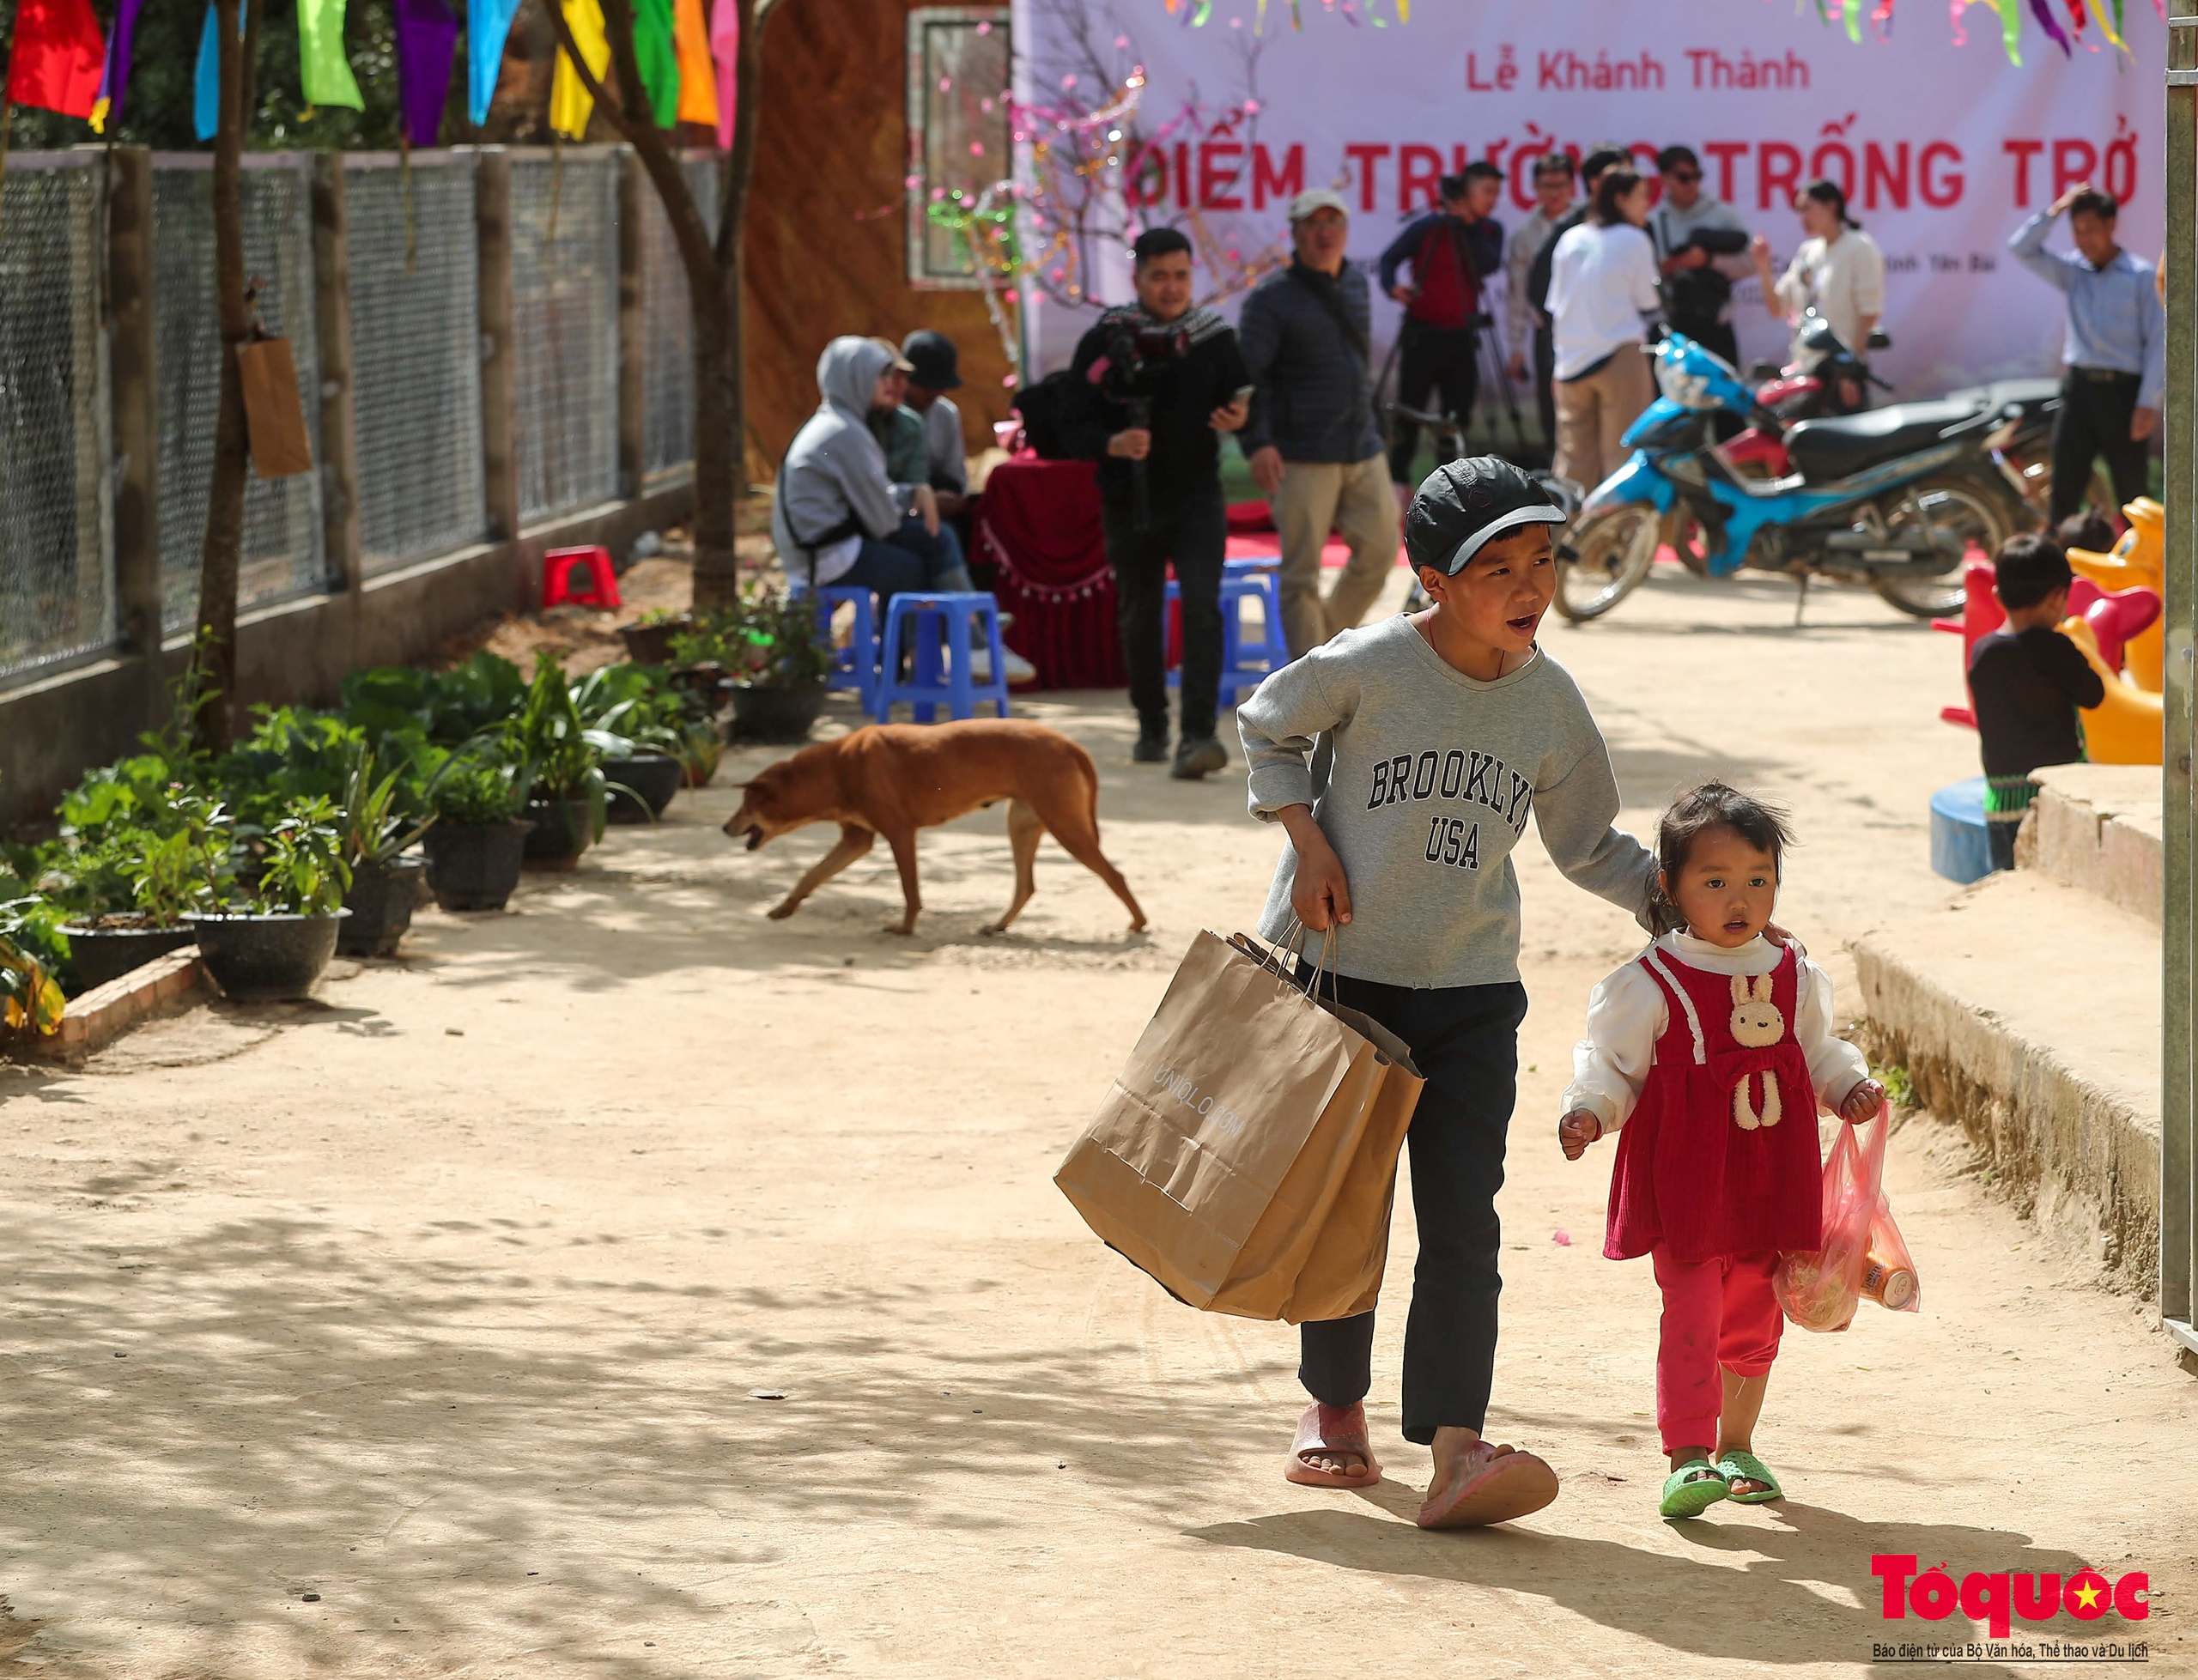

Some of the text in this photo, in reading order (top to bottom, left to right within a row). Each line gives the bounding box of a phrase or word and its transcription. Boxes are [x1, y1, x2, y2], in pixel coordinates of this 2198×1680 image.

[1466, 45, 1810, 90] Lễ Khánh Thành
[1703, 112, 1964, 209] TRỐNG
[2003, 113, 2138, 209] TRỞ
[1424, 816, 1479, 870] USA
